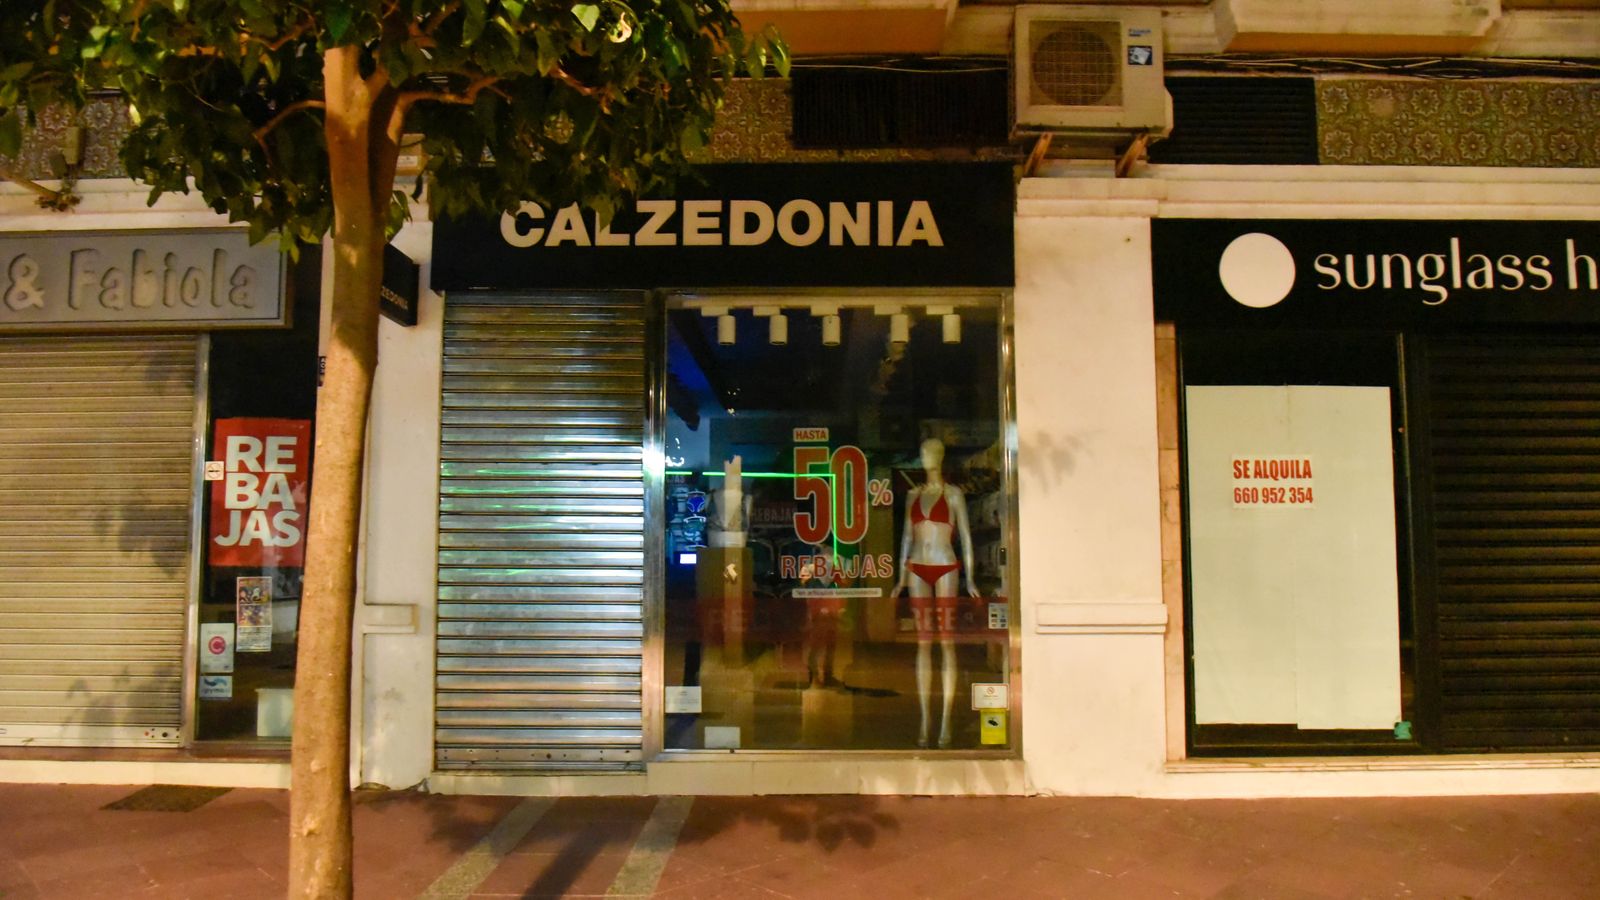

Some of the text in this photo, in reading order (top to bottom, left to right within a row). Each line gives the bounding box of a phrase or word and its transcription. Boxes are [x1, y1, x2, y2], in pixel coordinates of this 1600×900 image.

[500, 199, 944, 248] CALZEDONIA
[3, 246, 257, 313] & Fabiola
[1313, 236, 1553, 306] sunglass
[795, 429, 827, 440] HASTA
[225, 435, 298, 473] RE
[1233, 459, 1312, 481] SE ALQUILA
[224, 472, 297, 510] BA
[1234, 487, 1314, 504] 660 952 354
[214, 510, 301, 547] JAS
[780, 553, 894, 580] REBAJAS
